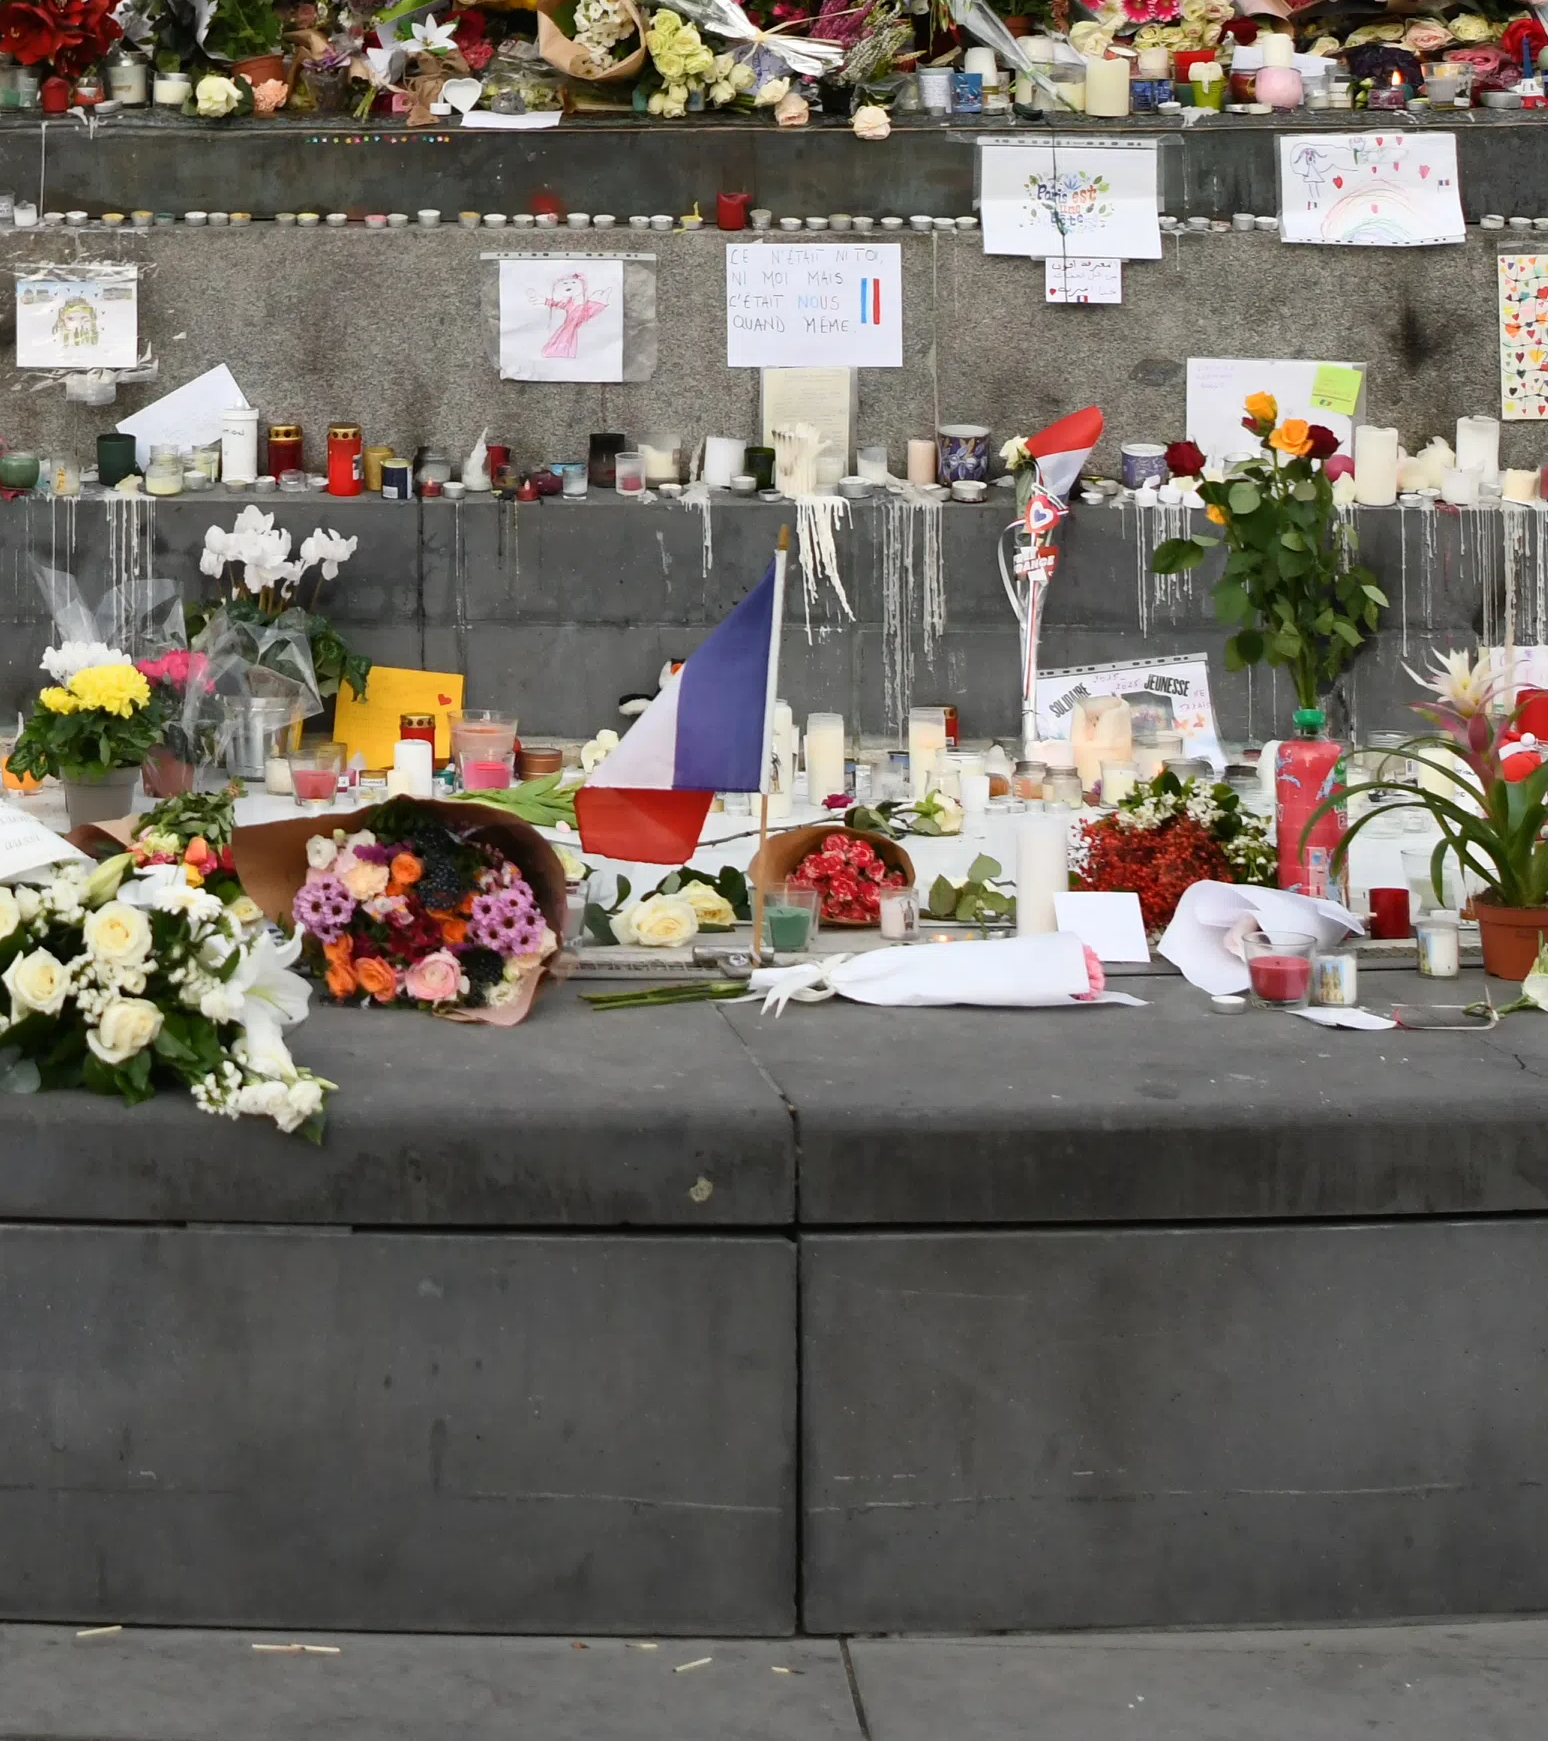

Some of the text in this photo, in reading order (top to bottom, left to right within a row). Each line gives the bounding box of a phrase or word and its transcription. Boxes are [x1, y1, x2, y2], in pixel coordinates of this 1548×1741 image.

[1037, 183, 1096, 204] Paris est
[730, 249, 748, 265] CE
[732, 272, 747, 286] NI
[763, 271, 788, 288] MOI
[798, 296, 840, 310] NOUS
[733, 314, 785, 333] QUAND
[1144, 674, 1190, 697] JEUNESSE
[1049, 682, 1092, 718] SOLIDAIRE
